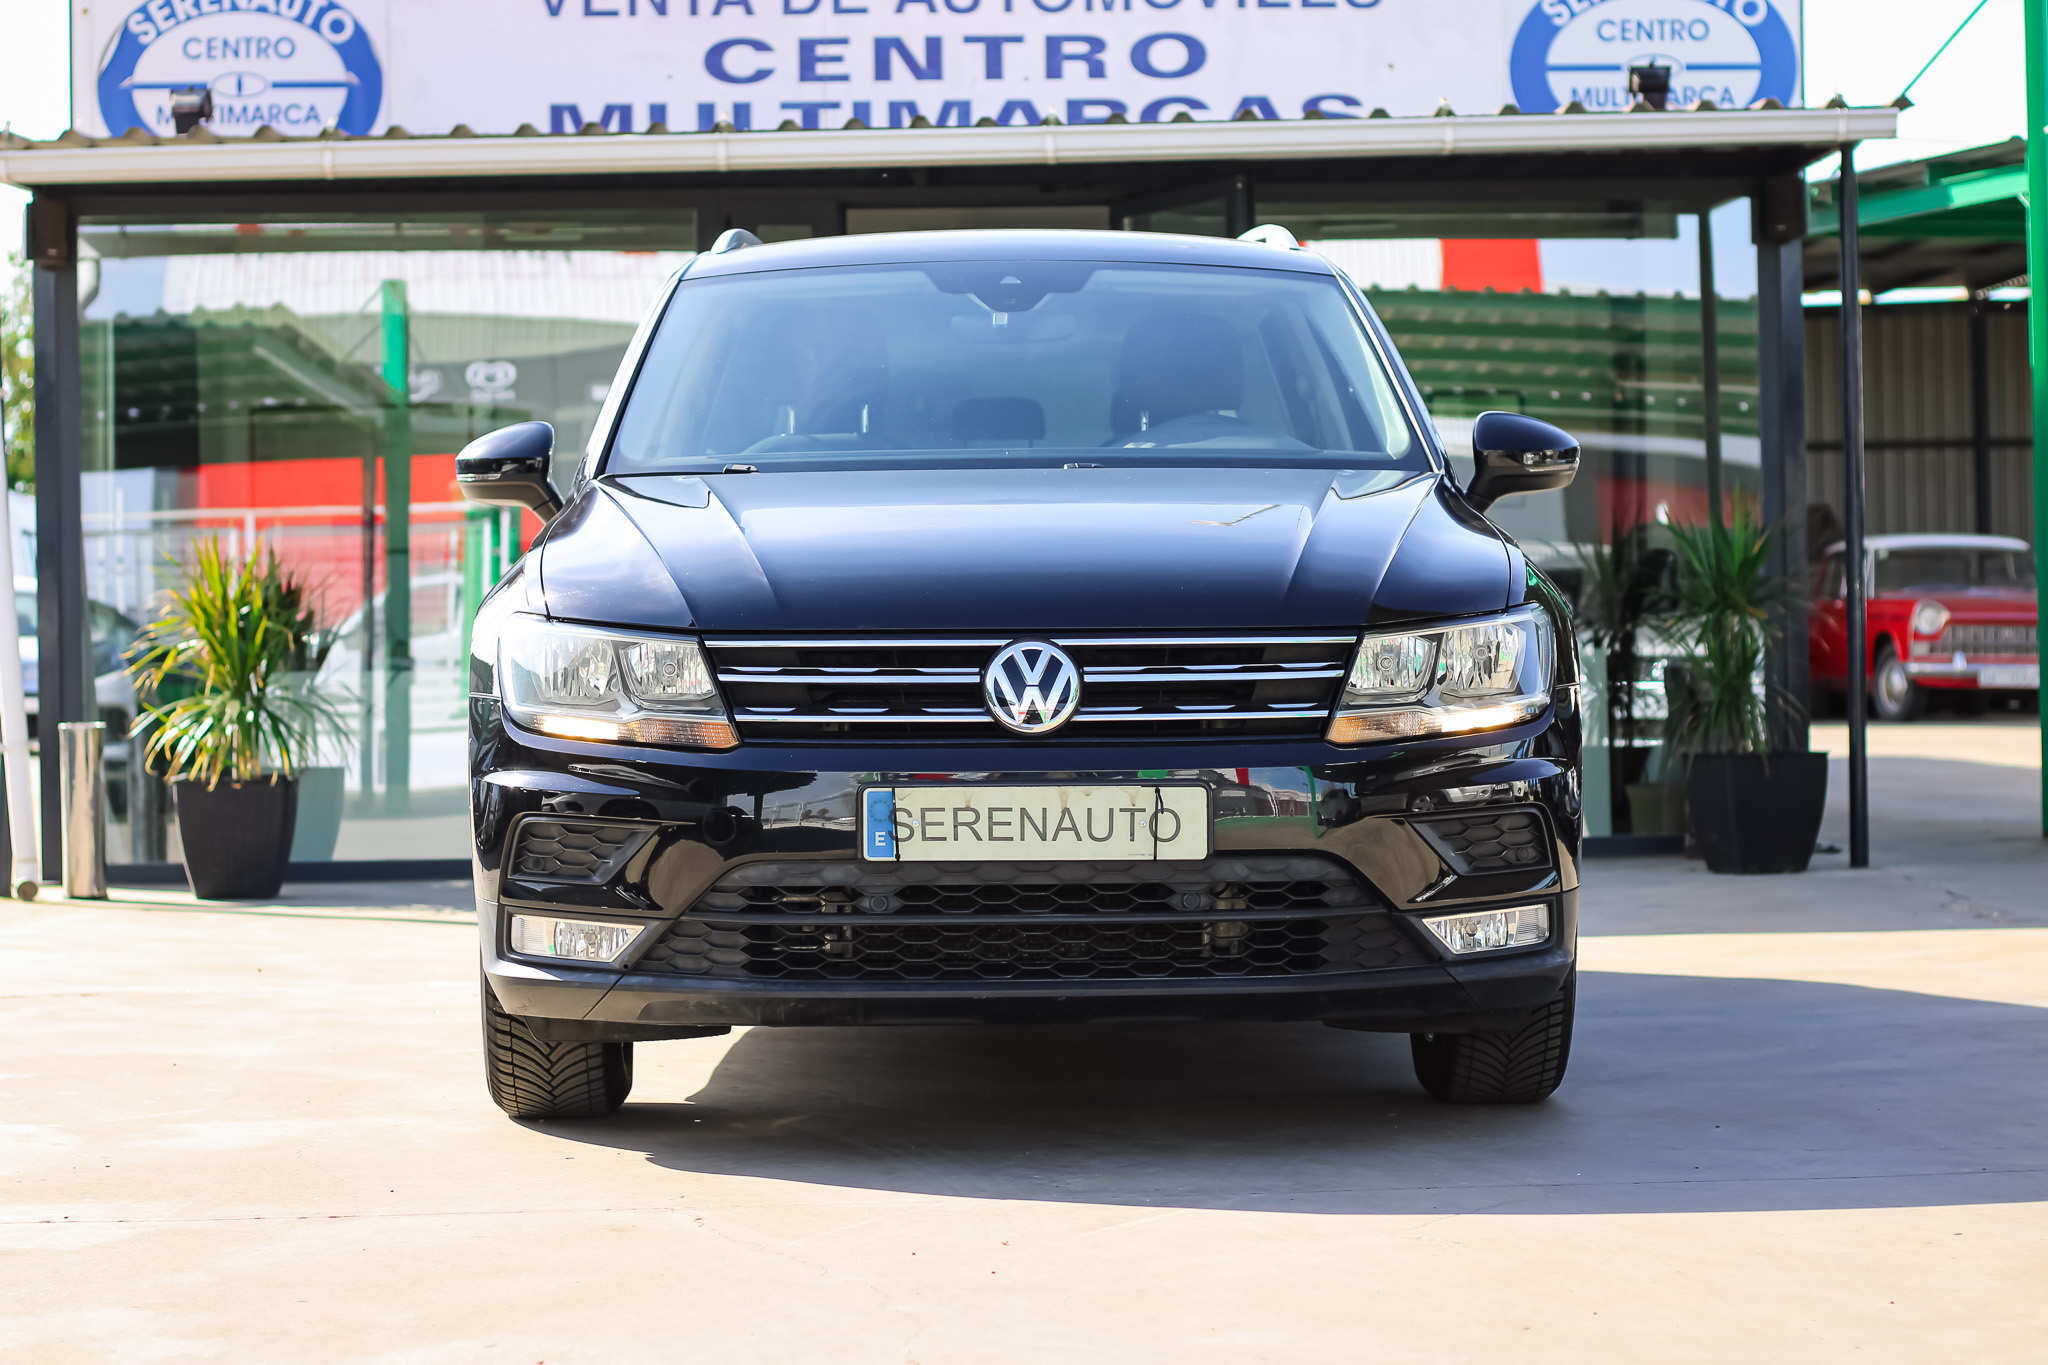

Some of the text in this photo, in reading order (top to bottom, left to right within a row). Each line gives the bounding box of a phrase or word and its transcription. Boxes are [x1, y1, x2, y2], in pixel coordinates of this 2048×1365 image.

[1594, 18, 1710, 42] CENTRO
[182, 36, 296, 60] CENTRO
[703, 32, 1208, 84] CENTRO
[1570, 84, 1737, 107] MULTARCA
[156, 103, 322, 125] MIMARCA
[887, 807, 1182, 843] SERENAUTO
[875, 831, 887, 847] E
